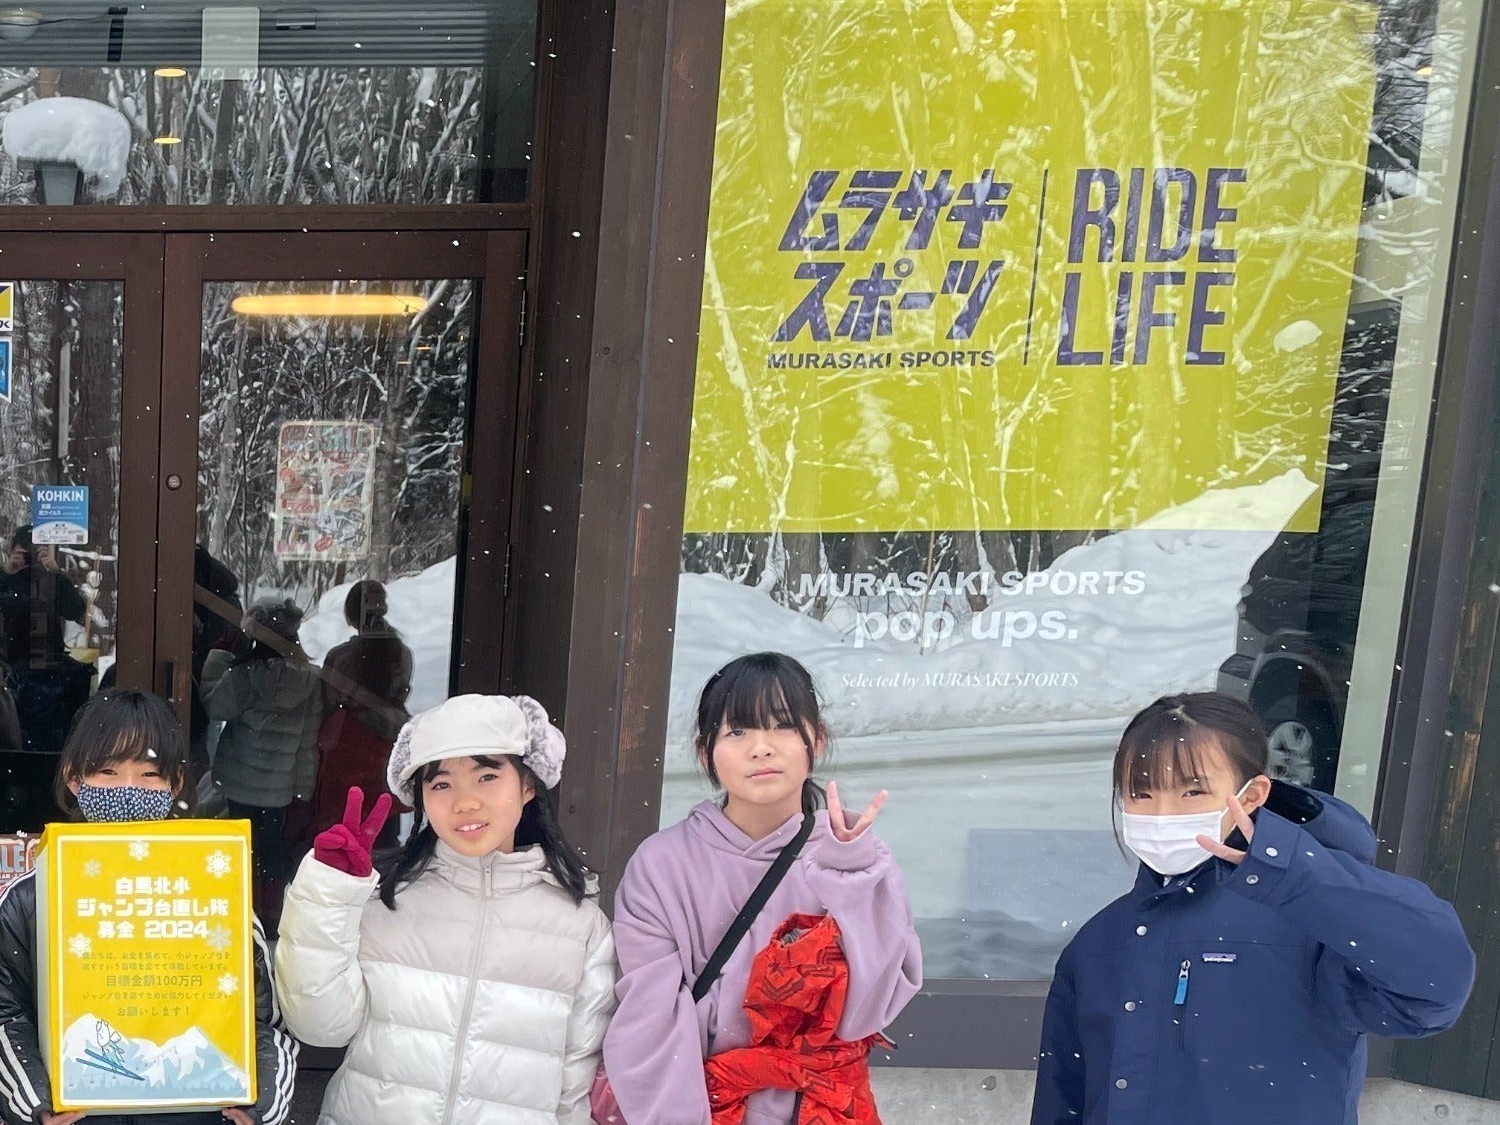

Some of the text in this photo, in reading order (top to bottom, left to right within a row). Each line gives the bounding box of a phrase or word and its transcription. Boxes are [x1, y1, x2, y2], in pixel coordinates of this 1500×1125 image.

[778, 169, 1013, 252] ムラサキ
[1067, 168, 1248, 264] RIDE
[770, 257, 1006, 342] スポーツ
[1056, 272, 1235, 365] LIFE
[767, 350, 996, 369] MURASAKI SPORTS
[37, 489, 84, 502] KOHKIN
[799, 571, 1147, 597] MURASAKI SPORTS
[853, 609, 1079, 648] pop ups.
[841, 672, 1080, 690] Selected by MURASAKI SPORTS
[115, 876, 191, 895] 白馬北小
[77, 898, 229, 917] ジャンプ台直し隊
[97, 919, 209, 939] 募金 2024
[106, 975, 203, 987] 目標金額100万円
